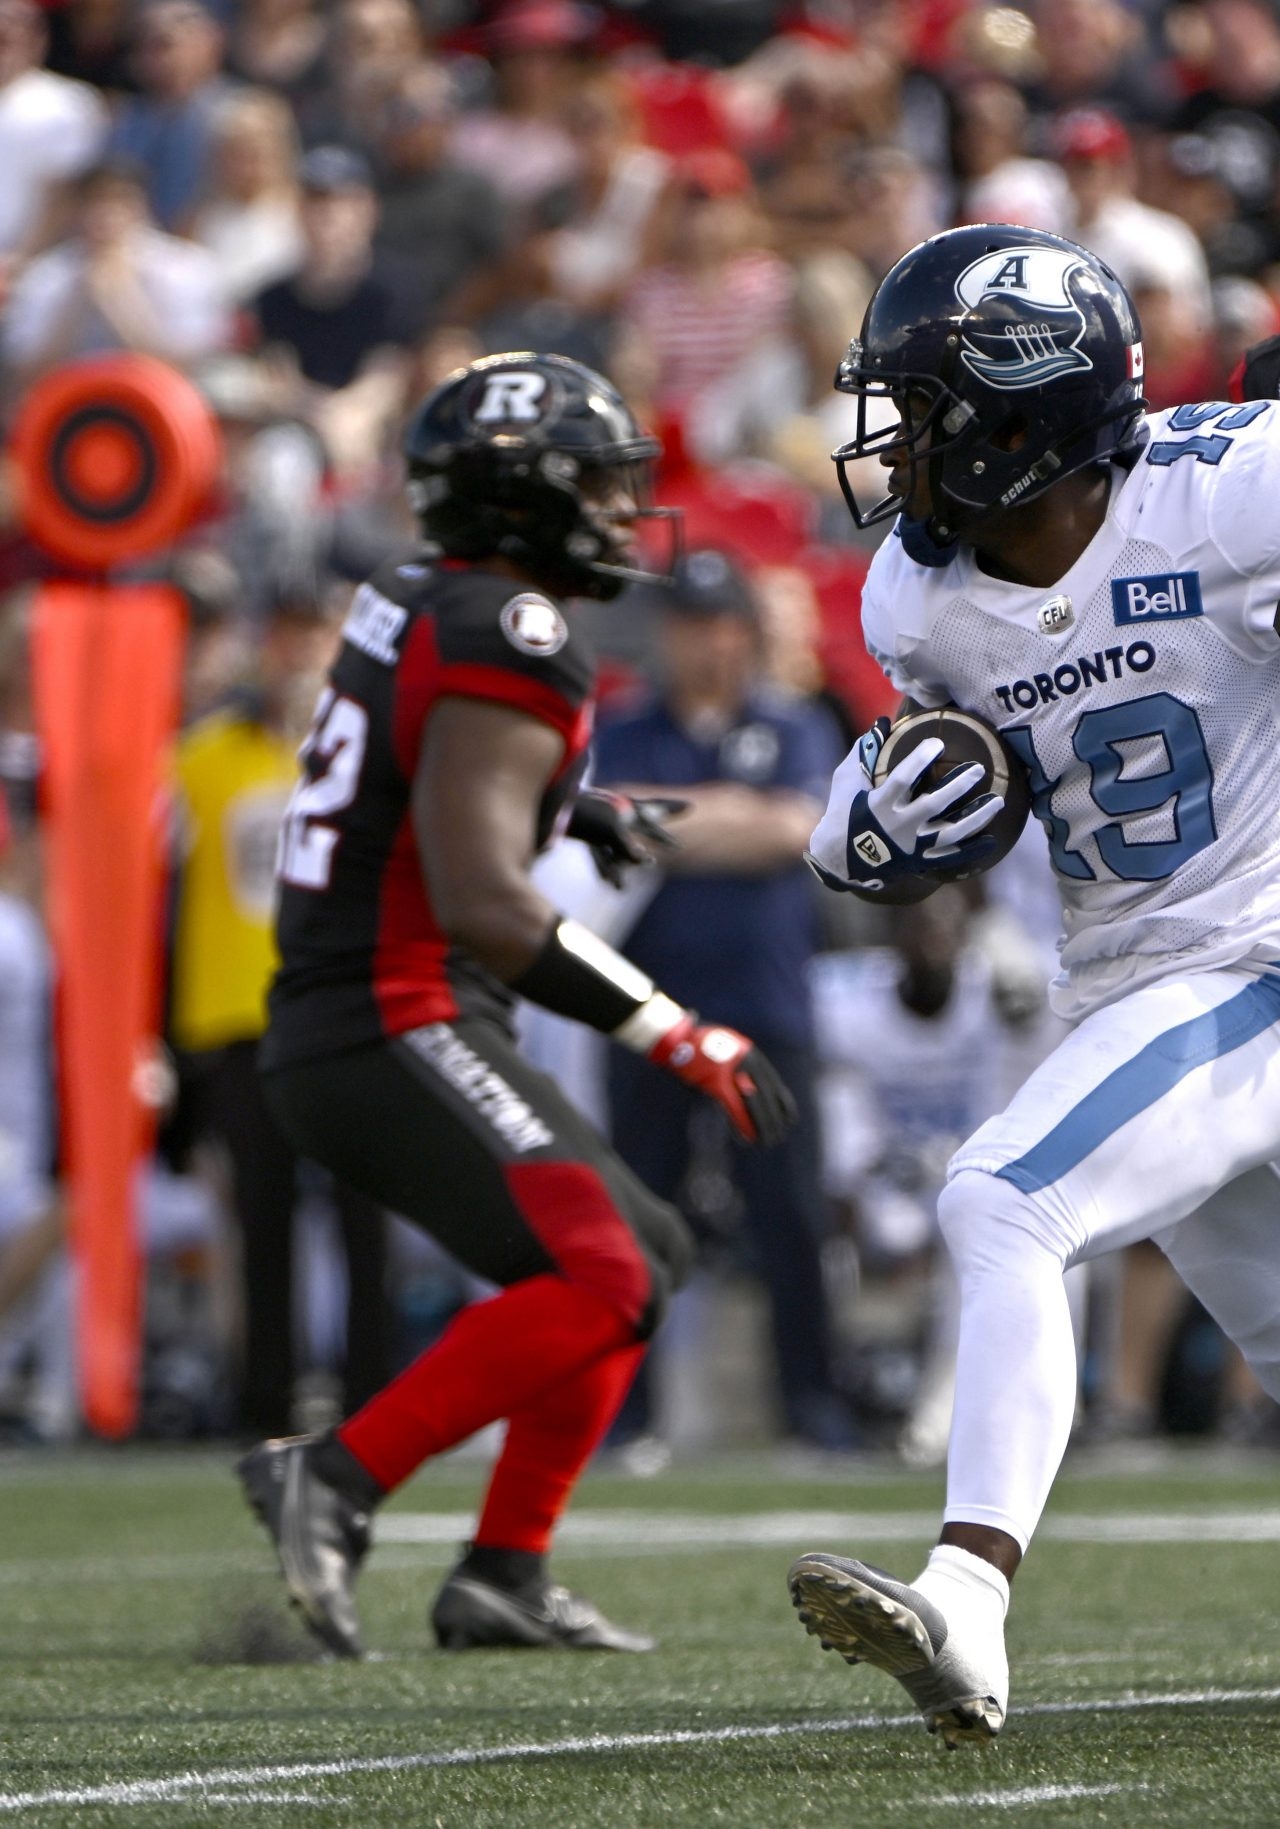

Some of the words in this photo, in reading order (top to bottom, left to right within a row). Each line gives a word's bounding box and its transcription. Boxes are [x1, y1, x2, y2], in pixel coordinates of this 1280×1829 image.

[985, 255, 1030, 290] A
[474, 372, 546, 423] R
[1001, 470, 1037, 506] schut
[1042, 605, 1068, 626] CFL
[1127, 578, 1188, 617] Bell
[995, 640, 1157, 713] TORONTO
[1000, 690, 1218, 882] 19
